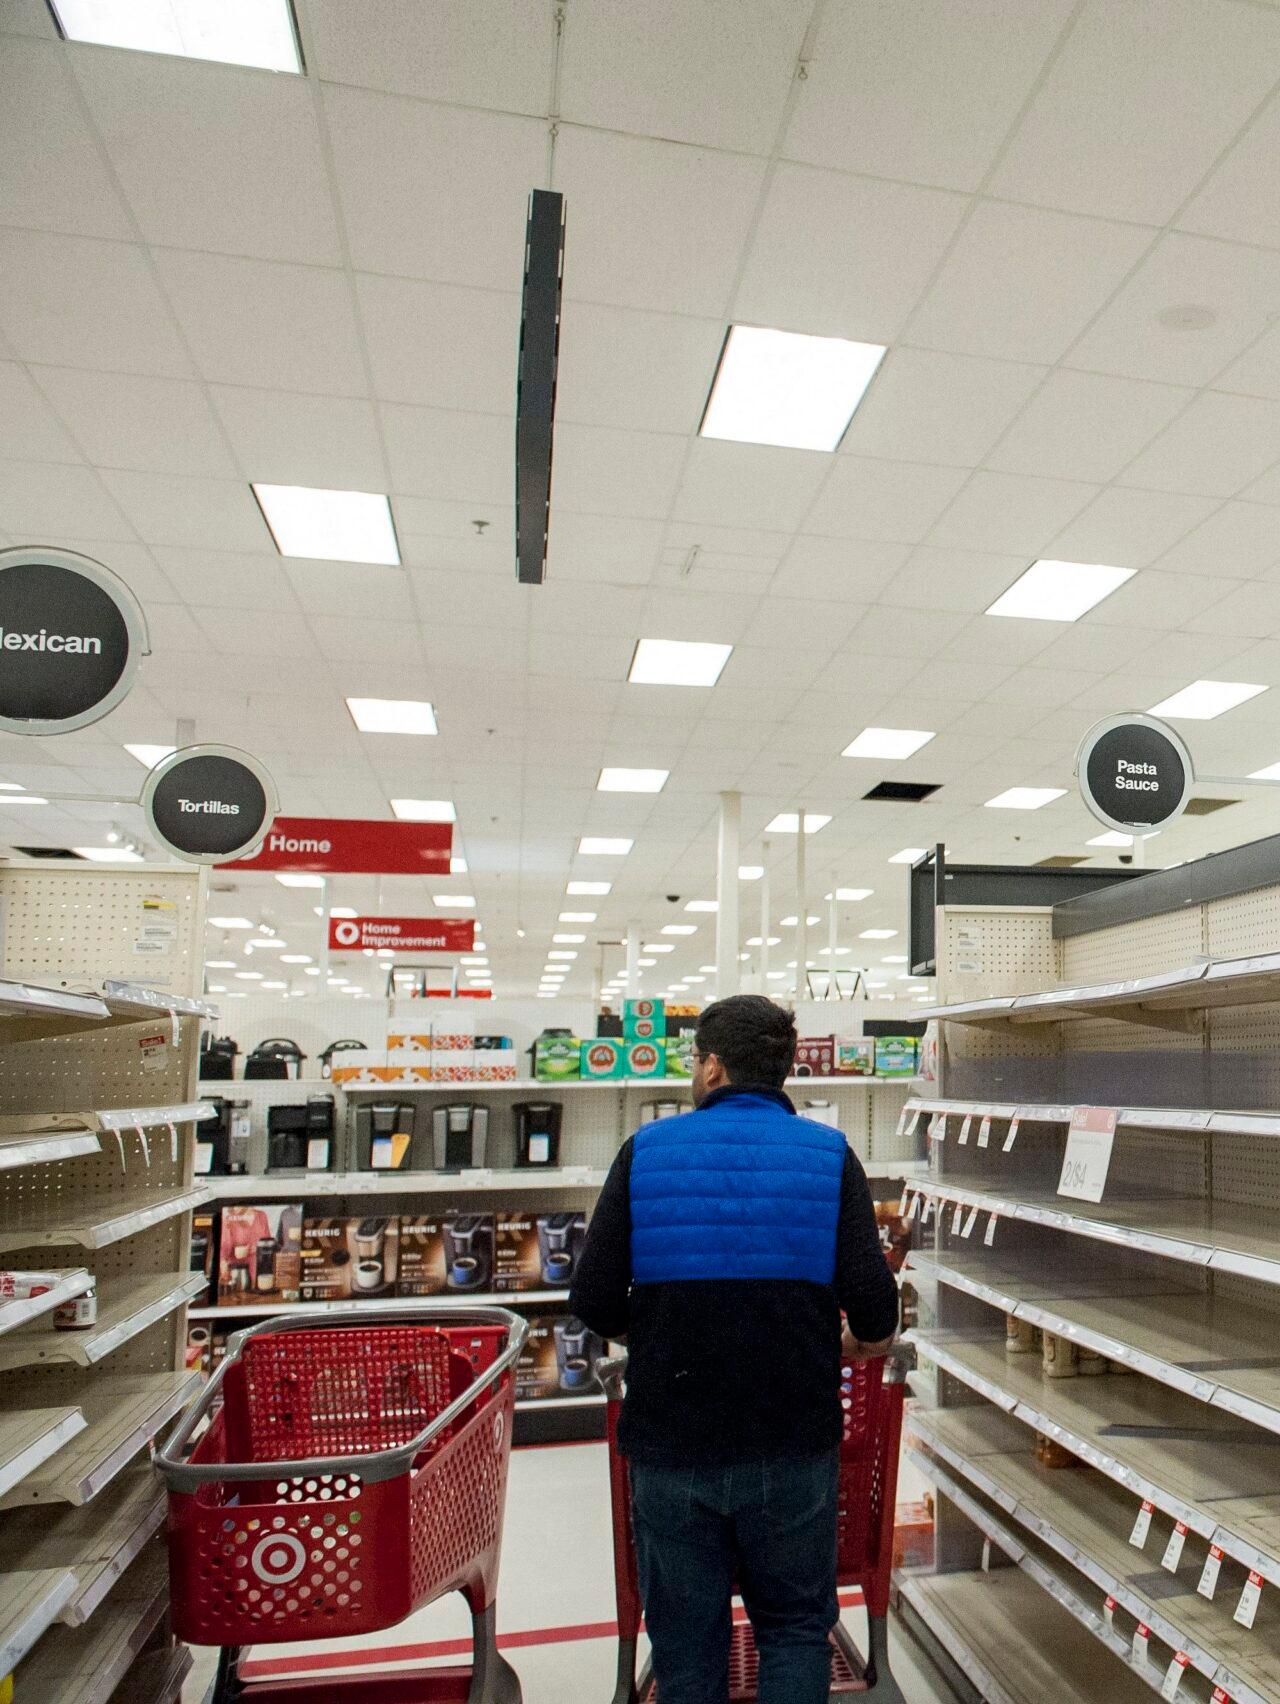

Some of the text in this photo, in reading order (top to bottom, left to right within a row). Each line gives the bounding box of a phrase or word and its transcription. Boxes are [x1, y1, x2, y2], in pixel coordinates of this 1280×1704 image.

[0, 627, 101, 654] exican
[1117, 759, 1157, 775] Pasta
[1115, 775, 1159, 791] Sauce
[178, 799, 239, 815] Tortillas
[270, 834, 332, 853] Home
[361, 922, 400, 935] Home
[361, 935, 447, 948] Improvement
[304, 1227, 341, 1238] KEURIG
[402, 1225, 437, 1235] KEURIG
[497, 1222, 532, 1233] KEURIG
